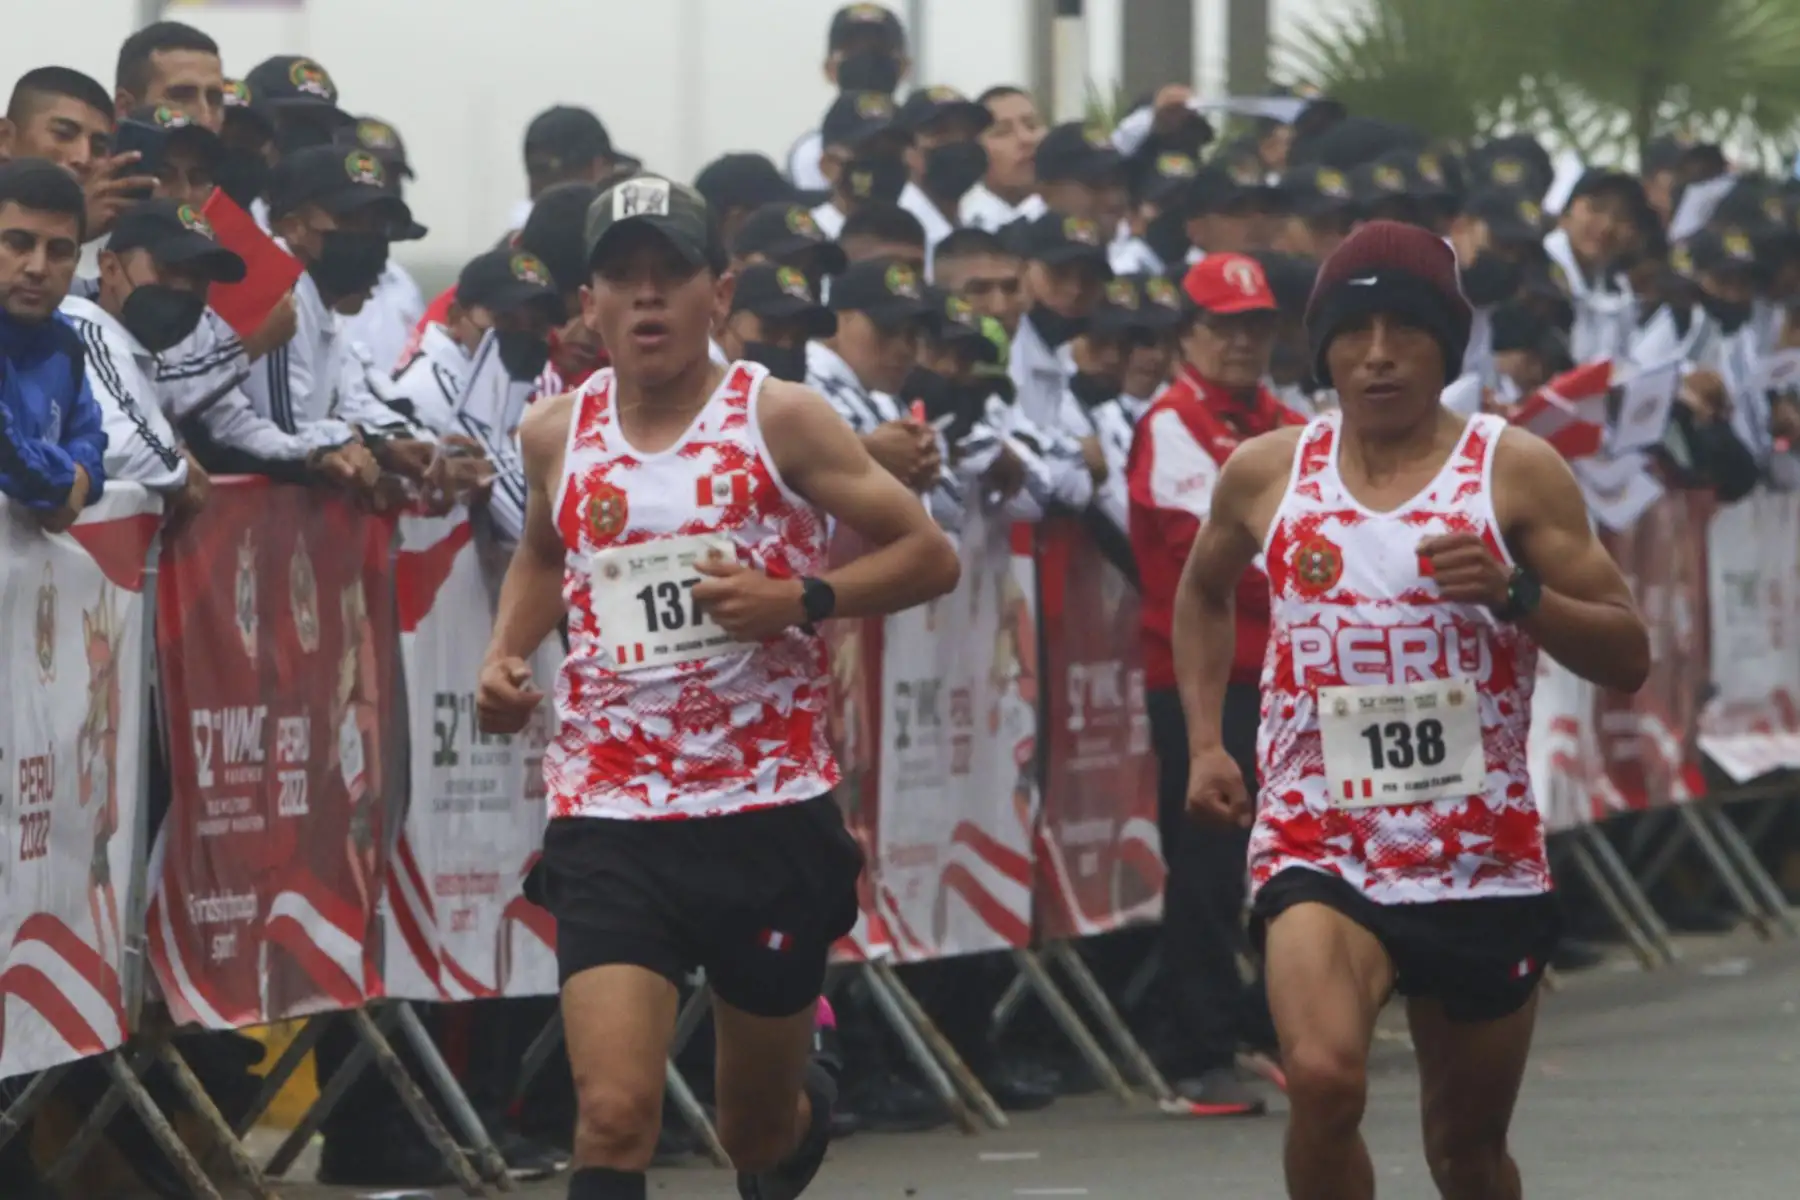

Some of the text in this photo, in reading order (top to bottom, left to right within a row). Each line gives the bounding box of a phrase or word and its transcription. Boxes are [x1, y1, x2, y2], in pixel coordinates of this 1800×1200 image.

[636, 578, 704, 632] 137
[1290, 624, 1493, 689] PERU
[1360, 719, 1446, 770] 138
[18, 739, 56, 806] PERÚ
[18, 809, 52, 862] 2022
